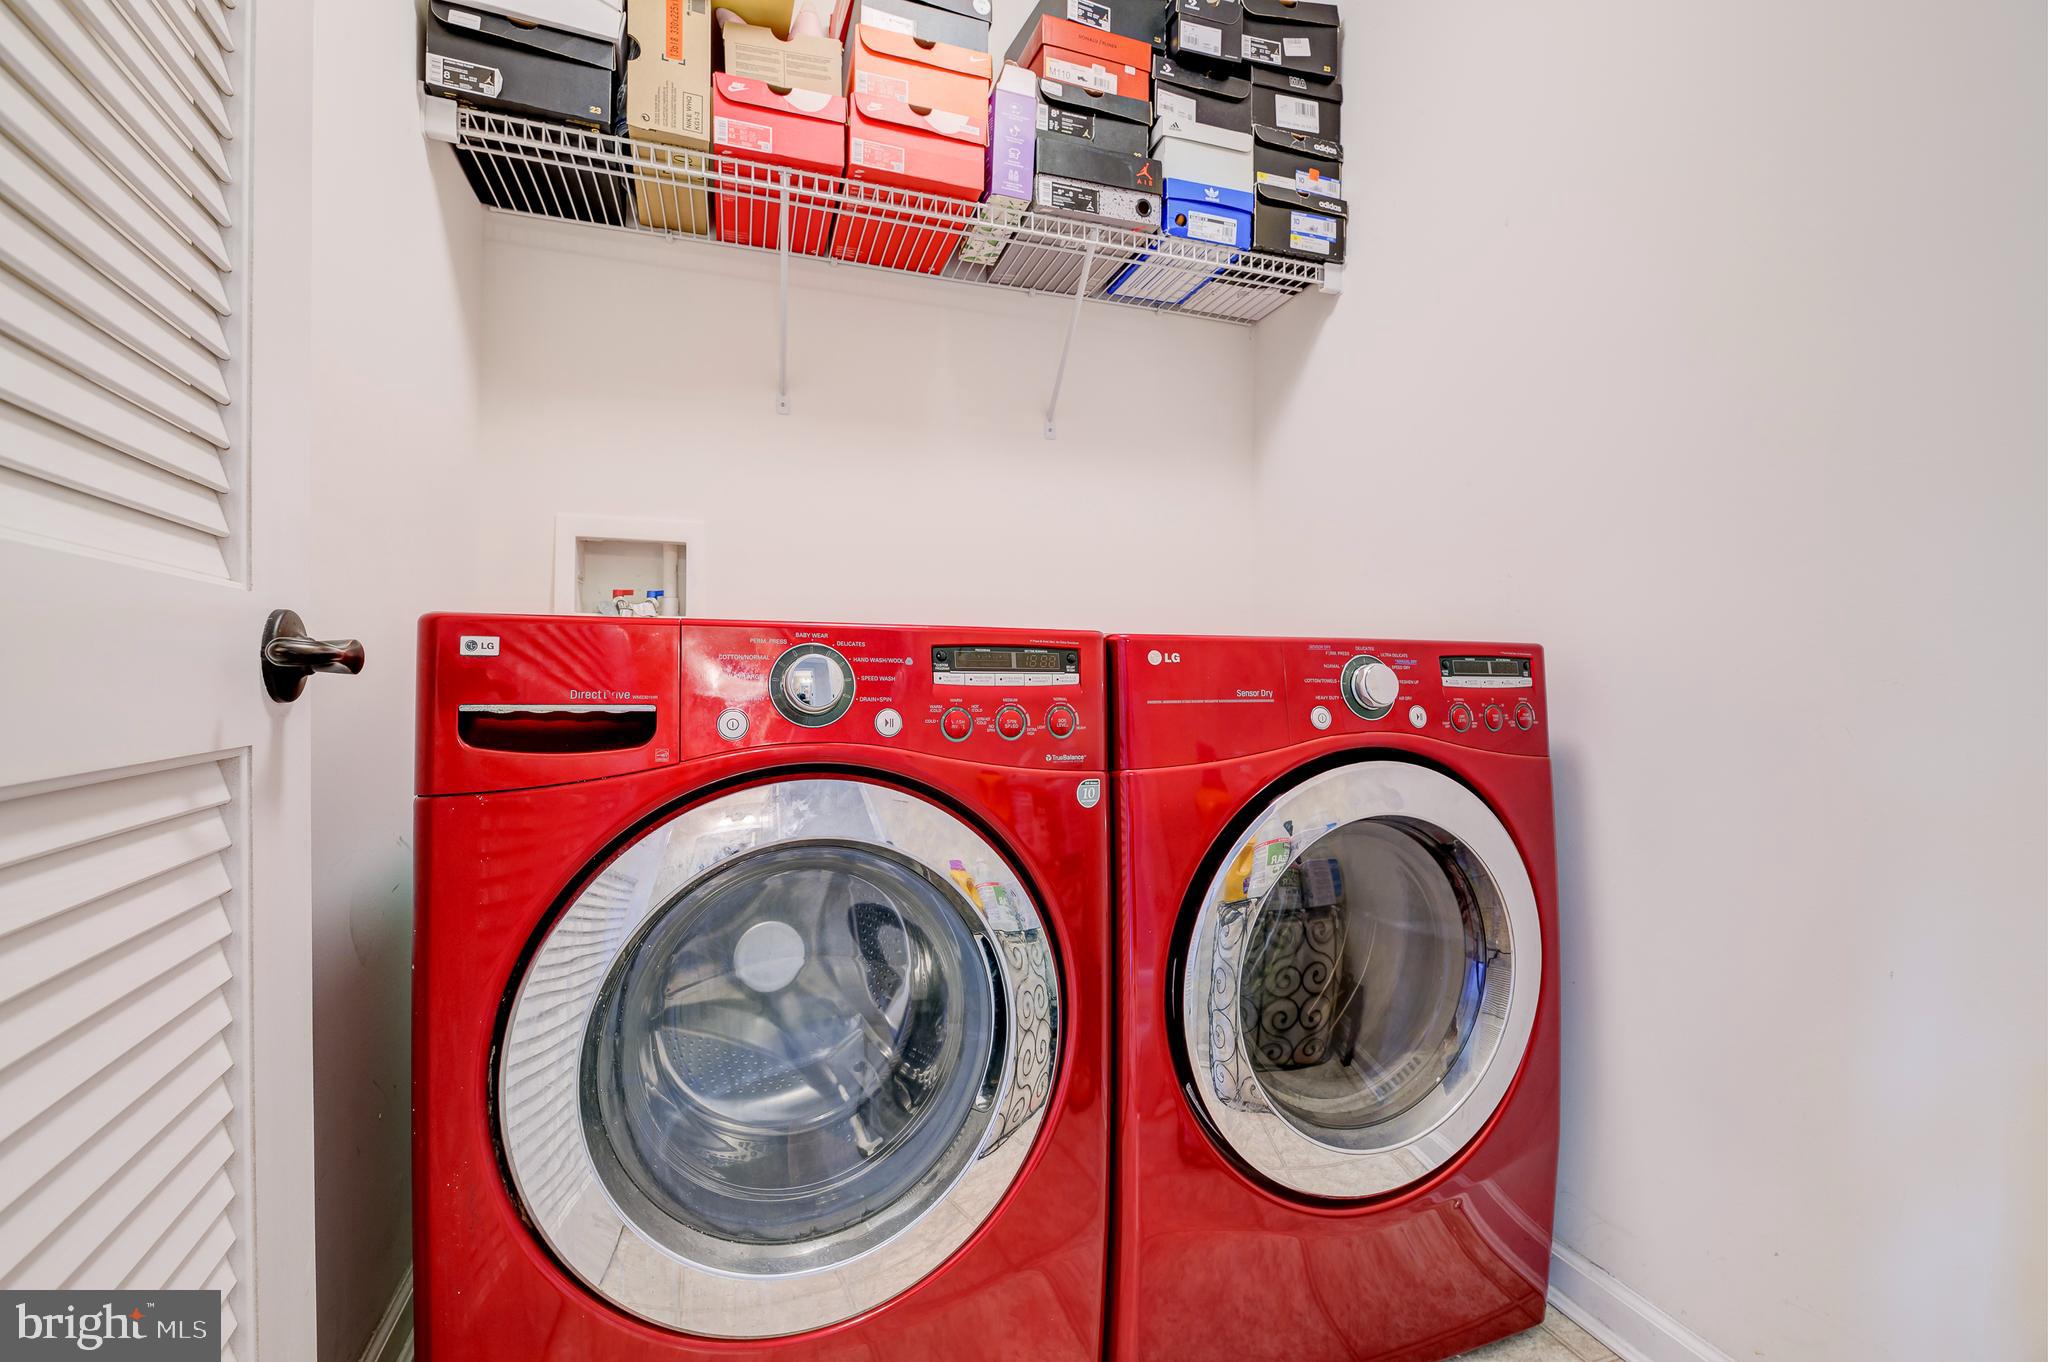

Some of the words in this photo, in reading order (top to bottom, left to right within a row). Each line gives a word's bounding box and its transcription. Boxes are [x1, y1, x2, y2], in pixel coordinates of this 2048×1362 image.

[443, 70, 451, 79] 8
[1313, 143, 1337, 155] adidas
[1318, 201, 1342, 212] adidas
[481, 642, 495, 650] LG
[836, 640, 866, 648] DELICATES
[1164, 652, 1181, 663] LG
[570, 689, 601, 700] Direct
[1236, 689, 1260, 697] Sensor
[1260, 689, 1274, 699] Dry
[1082, 786, 1096, 800] 10
